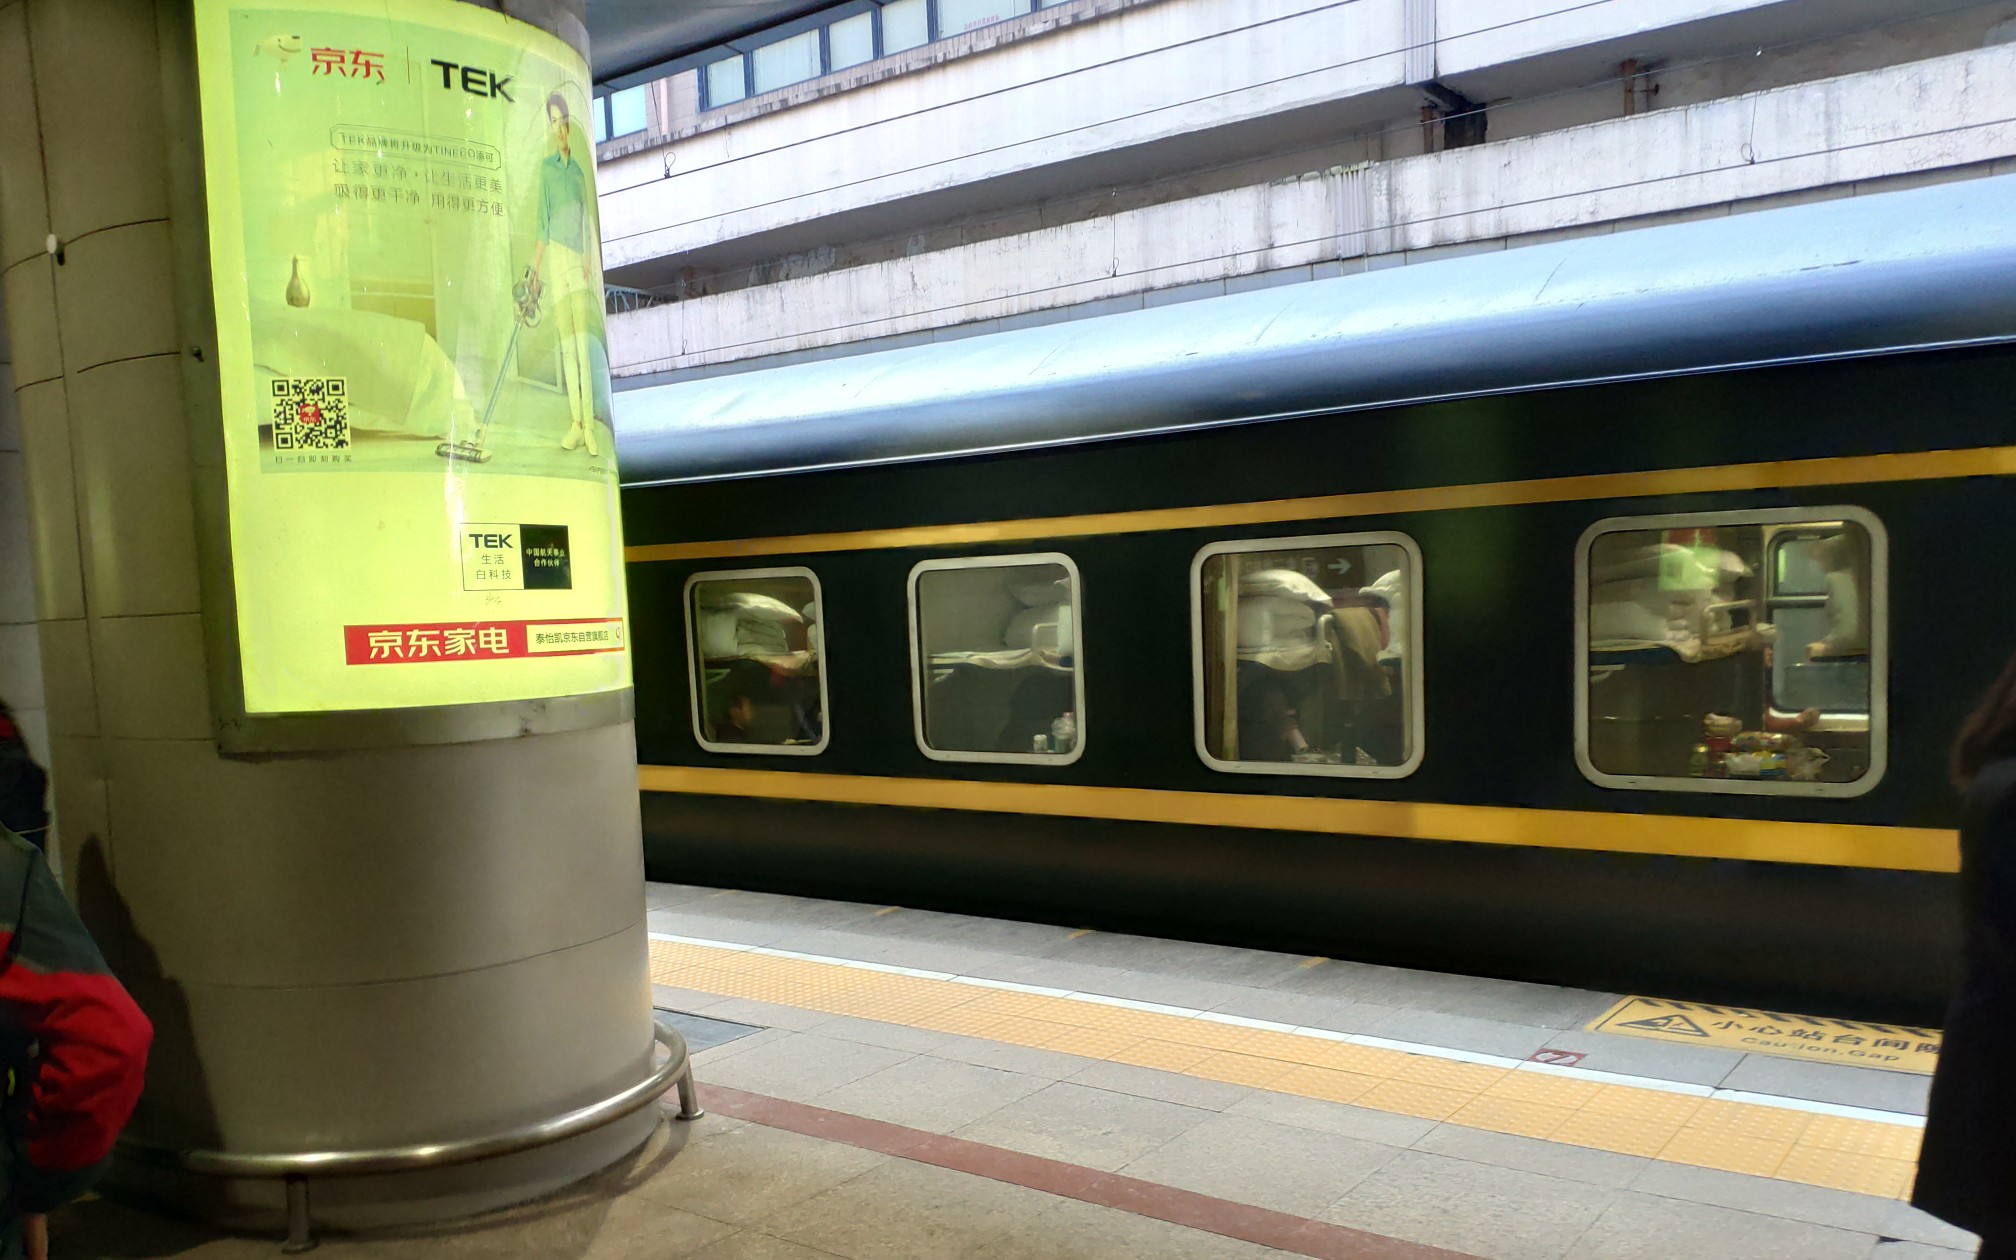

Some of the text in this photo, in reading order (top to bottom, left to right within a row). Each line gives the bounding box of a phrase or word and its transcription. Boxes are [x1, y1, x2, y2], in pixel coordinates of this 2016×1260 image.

[310, 47, 385, 81] 京东
[430, 58, 516, 103] TEK
[469, 533, 514, 549] TEK
[481, 554, 505, 565] 生活
[476, 569, 512, 580] 白科技
[367, 626, 609, 659] 京东家电 泰怡凯京东自营旗舰店
